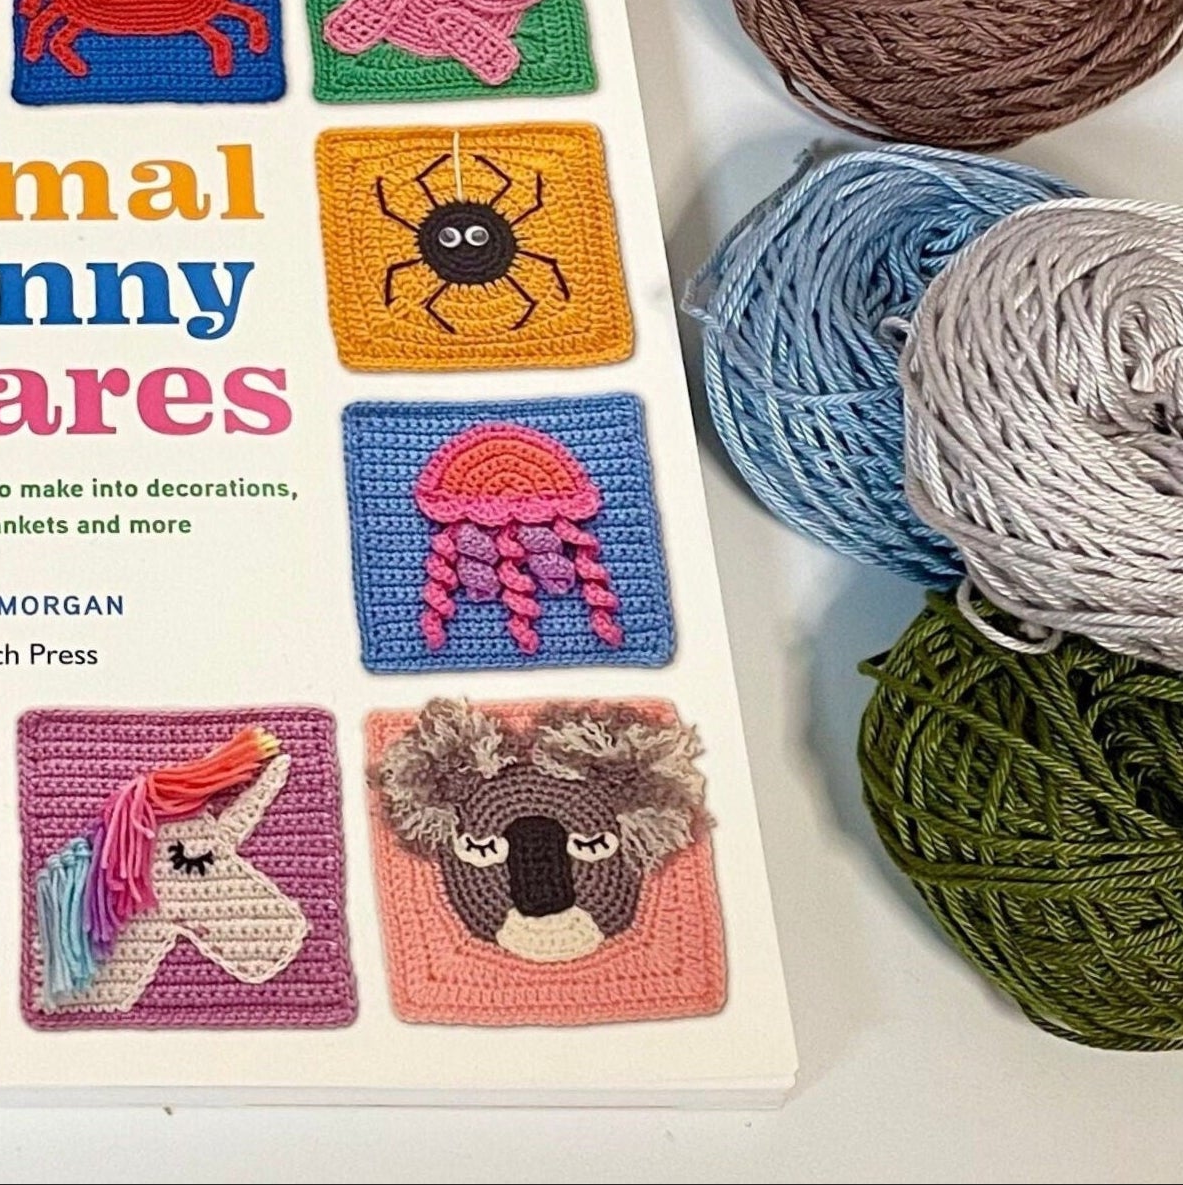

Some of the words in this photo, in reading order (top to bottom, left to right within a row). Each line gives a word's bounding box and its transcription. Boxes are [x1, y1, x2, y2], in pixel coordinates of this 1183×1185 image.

[20, 478, 84, 498] make
[92, 477, 138, 498] into
[146, 477, 298, 501] decorations,
[76, 514, 120, 535] and
[129, 519, 192, 535] more
[29, 642, 99, 666] Press
